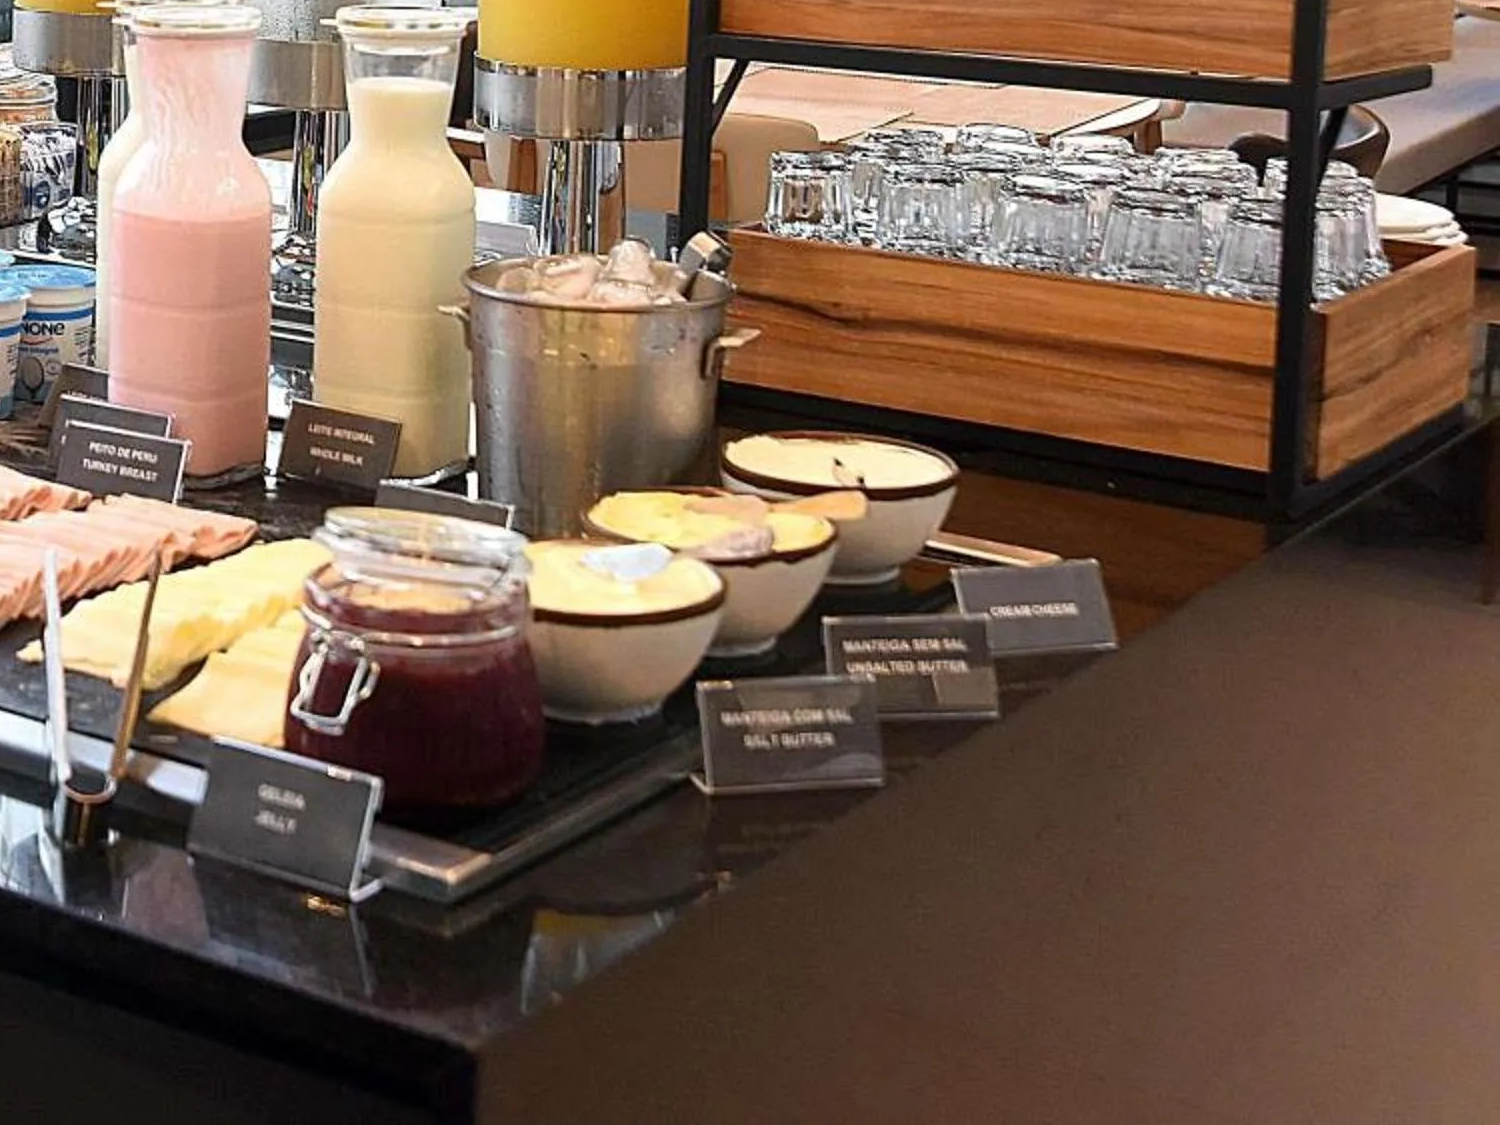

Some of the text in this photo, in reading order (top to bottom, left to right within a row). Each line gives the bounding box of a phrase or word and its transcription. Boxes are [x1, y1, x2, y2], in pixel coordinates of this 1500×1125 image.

[308, 422, 375, 445] LEITE INTEGRAL
[89, 441, 159, 464] PEITO DE PERU
[309, 446, 363, 466] WHOLE MILK
[83, 458, 159, 482] TURKEY BREAST
[989, 602, 1080, 618] CREAM CHEESE
[842, 637, 969, 653] MANTEIGA SEM SAL
[846, 659, 971, 675] UNSALTED BUTTER
[720, 707, 854, 726] MANTEIGA COM SAL
[743, 731, 836, 750] SALT BUTTER
